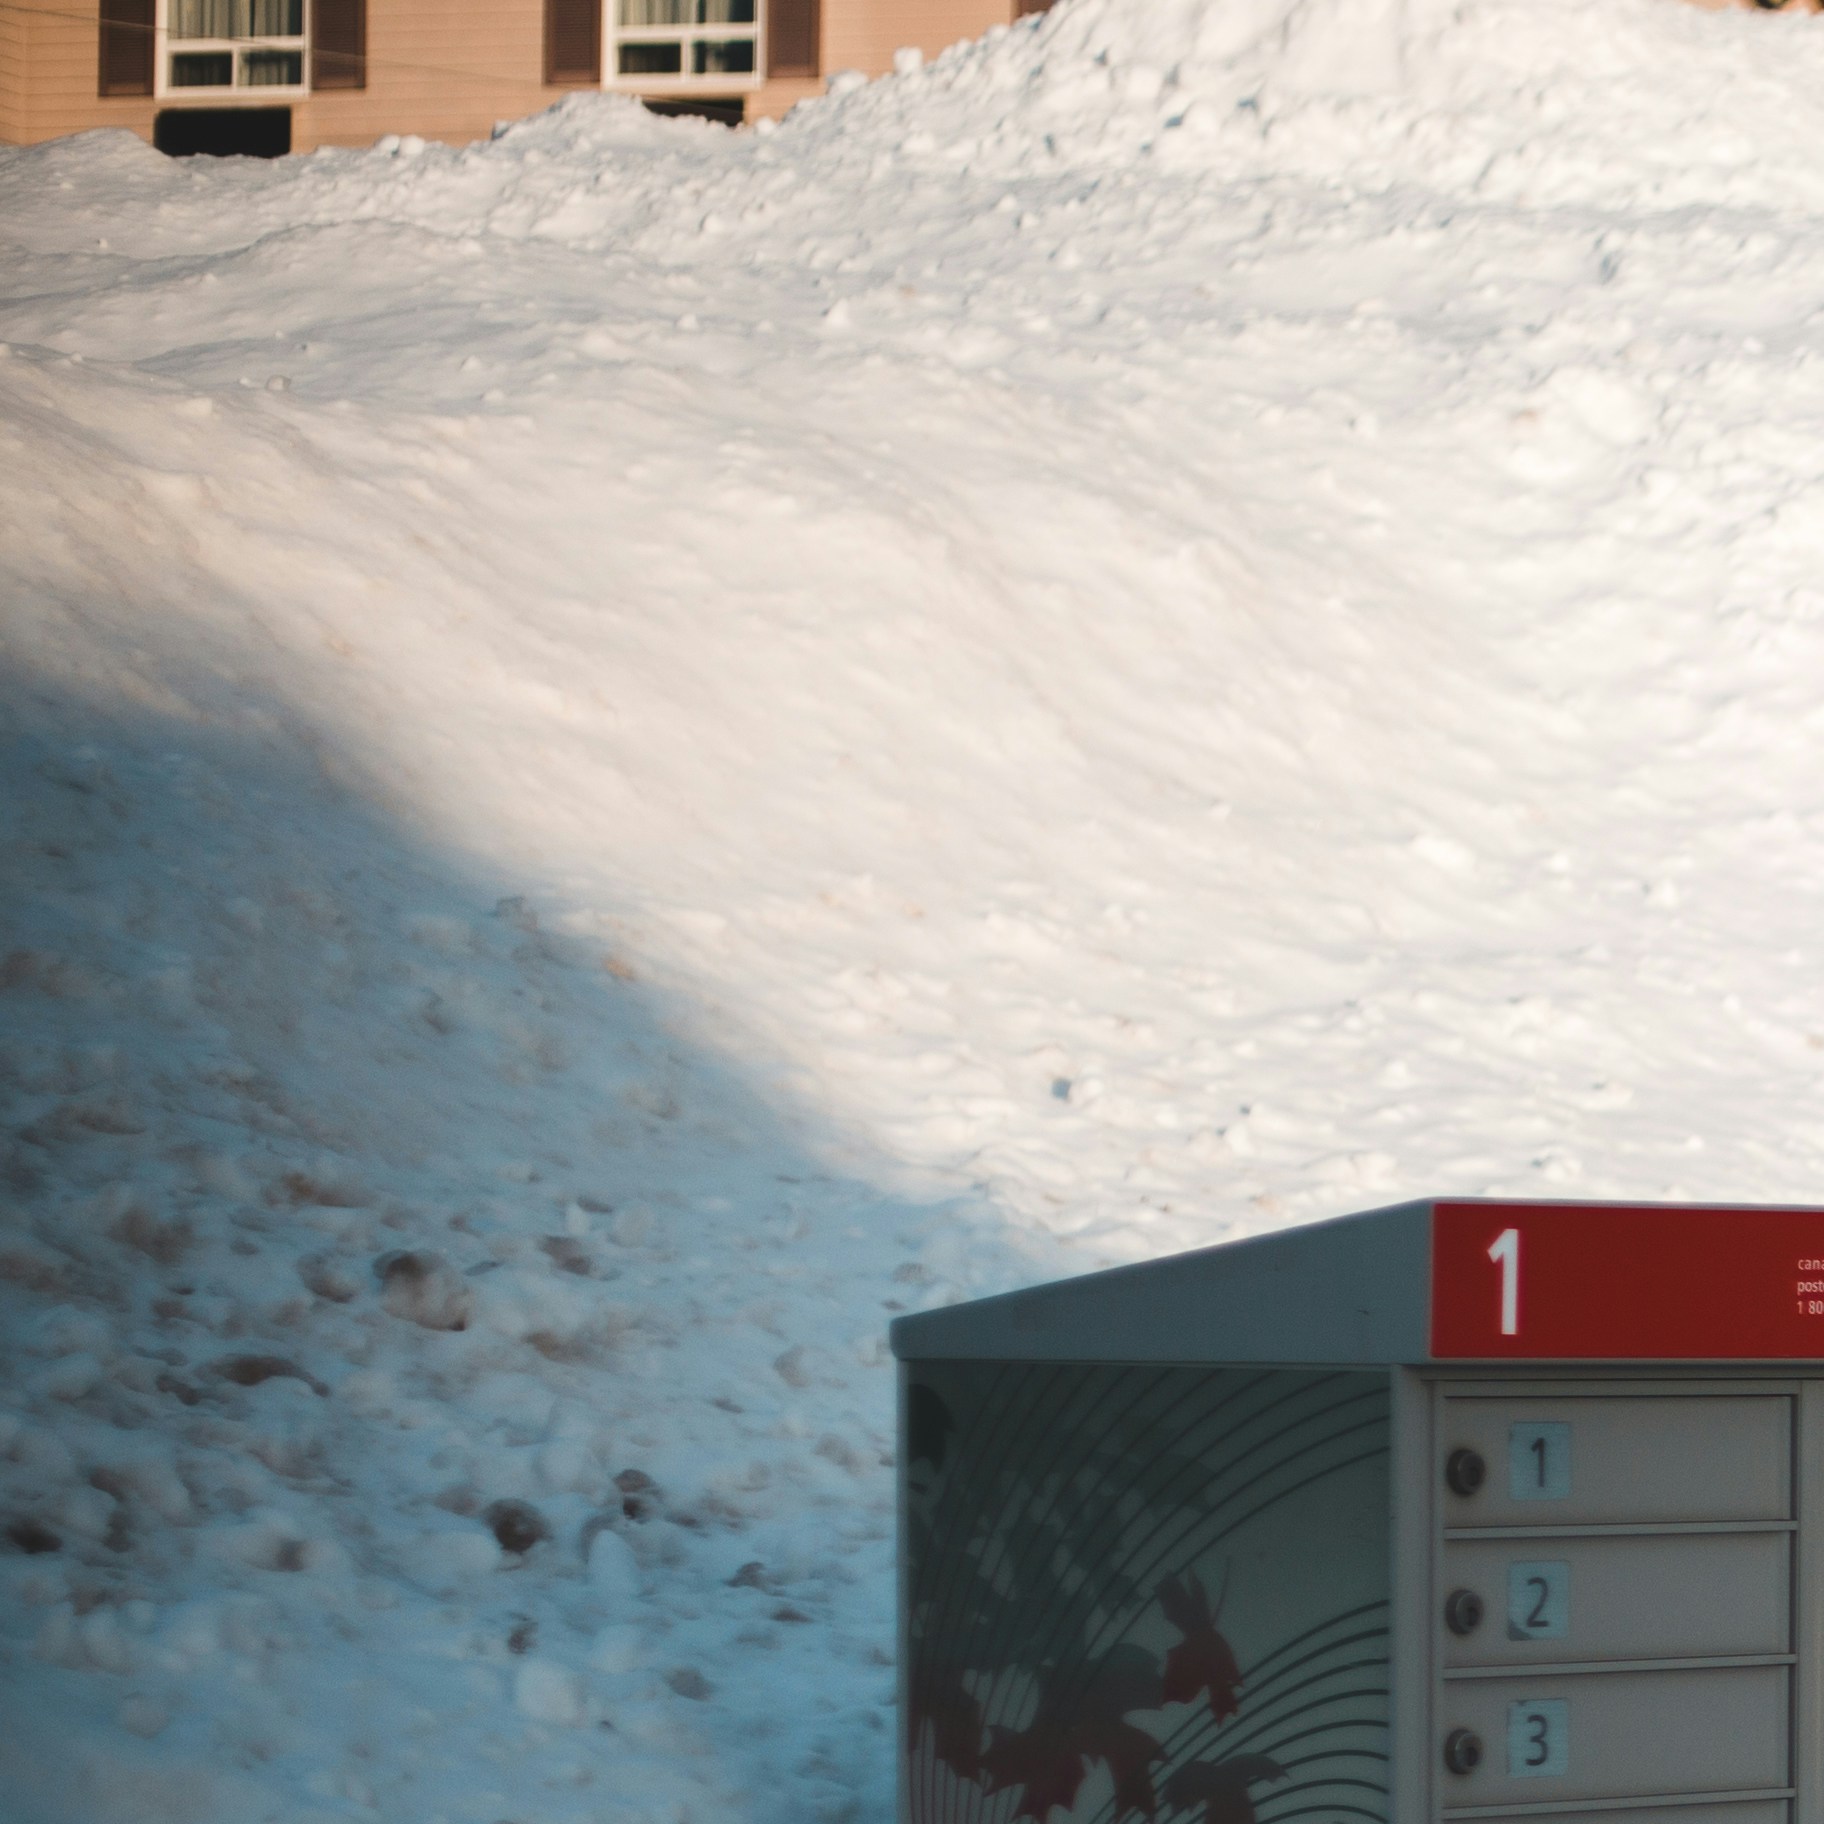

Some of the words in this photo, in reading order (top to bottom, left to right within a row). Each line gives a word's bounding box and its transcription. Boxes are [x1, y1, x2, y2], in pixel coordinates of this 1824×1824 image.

[1487, 1228, 1519, 1335] 1
[1797, 1301, 1803, 1314] 1
[1531, 1438, 1546, 1487] 1
[1526, 1577, 1549, 1628] 2
[1526, 1715, 1548, 1765] 3
